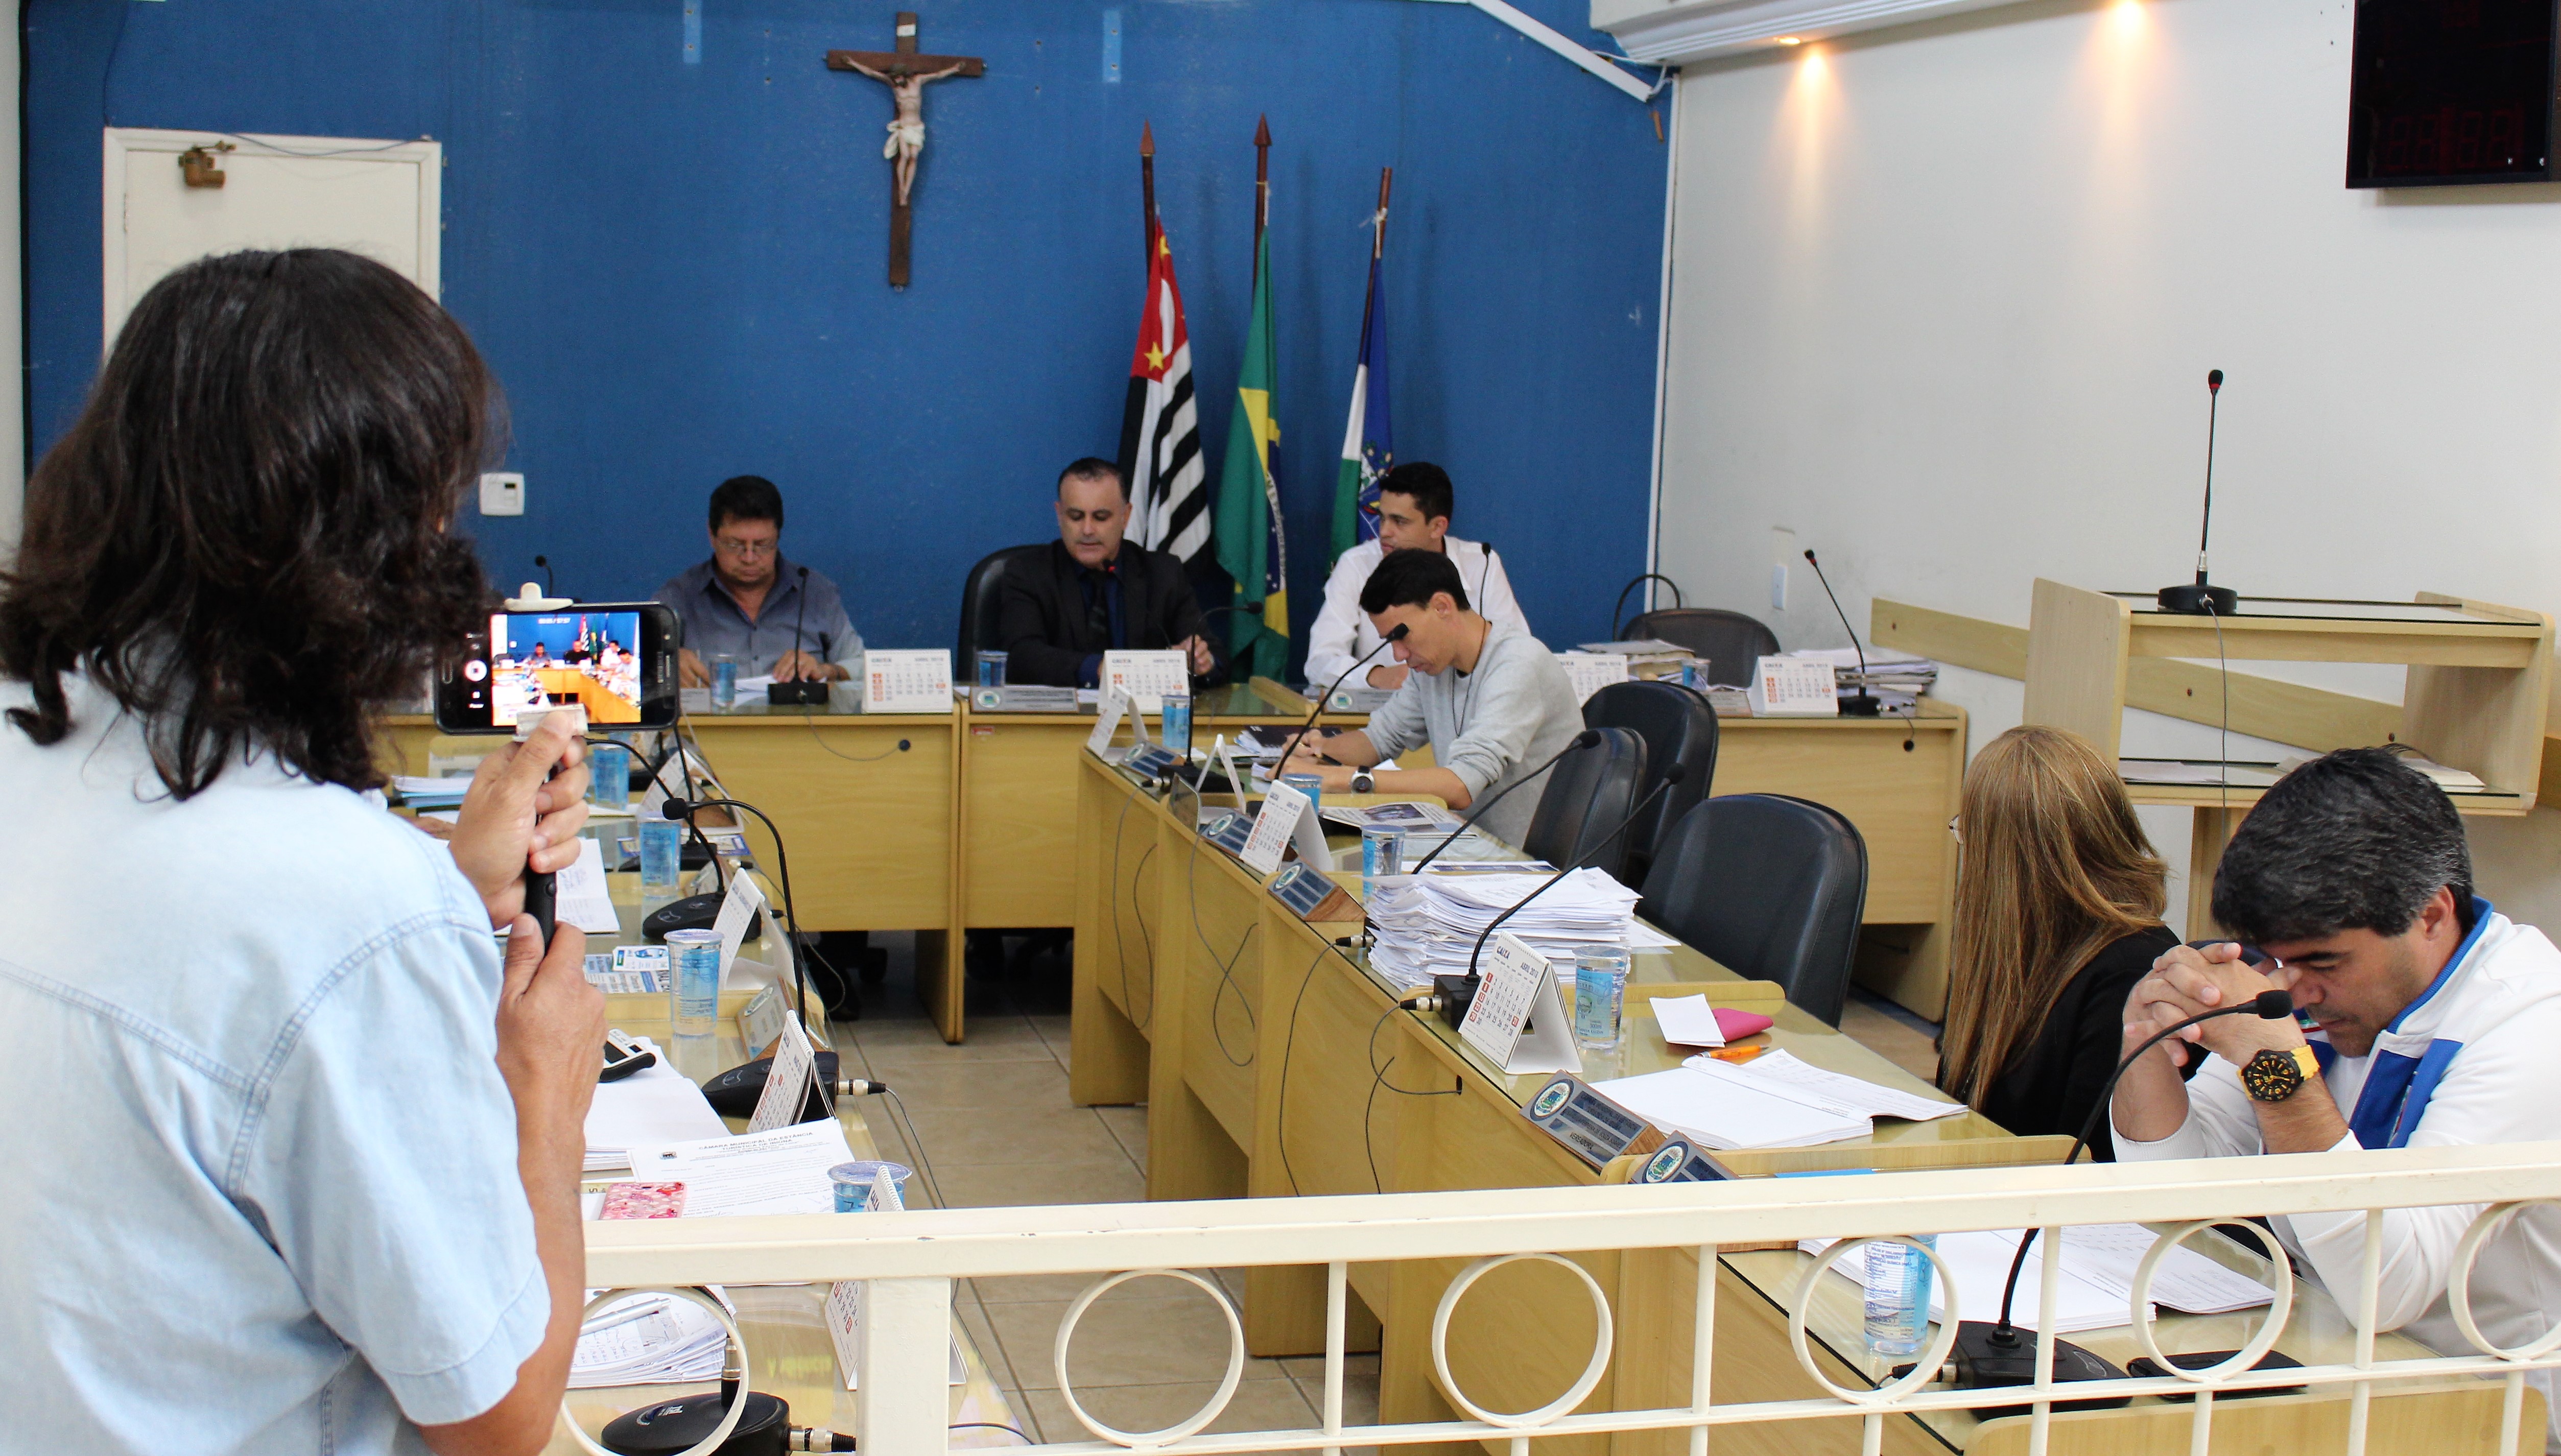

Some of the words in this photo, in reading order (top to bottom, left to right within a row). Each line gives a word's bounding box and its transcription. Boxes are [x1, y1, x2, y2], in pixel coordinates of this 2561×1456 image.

[1497, 946, 1510, 960] CAIXA
[779, 1131, 814, 1140] ESTÂNCIA
[1570, 1132, 1594, 1151] VEREADORA
